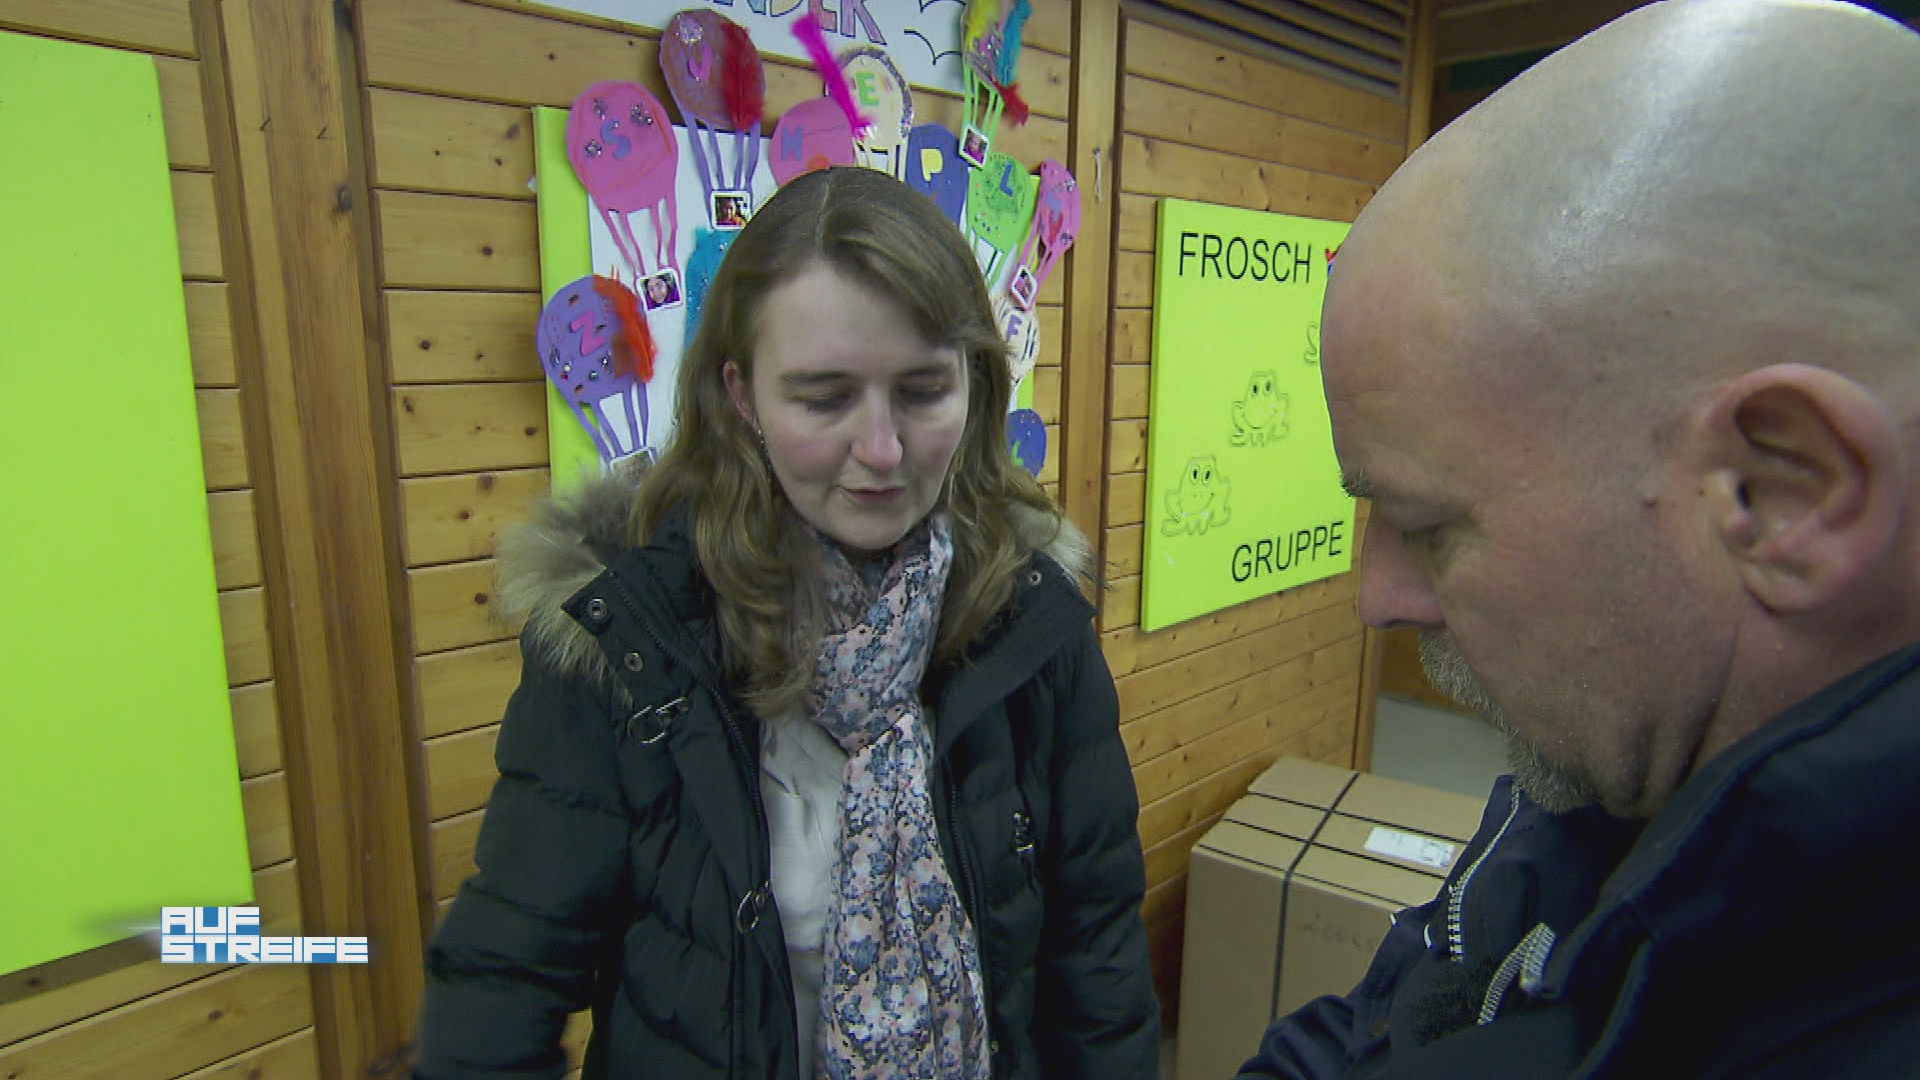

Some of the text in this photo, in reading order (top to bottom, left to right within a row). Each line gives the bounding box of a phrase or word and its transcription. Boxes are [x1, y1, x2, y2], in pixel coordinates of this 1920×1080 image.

[856, 73, 880, 106] E
[601, 119, 632, 159] S
[782, 127, 803, 162] N
[920, 148, 944, 182] P
[1000, 163, 1014, 198] L
[1179, 231, 1312, 284] FROSCH
[1006, 314, 1022, 343] F
[1231, 520, 1344, 583] GRUPPE
